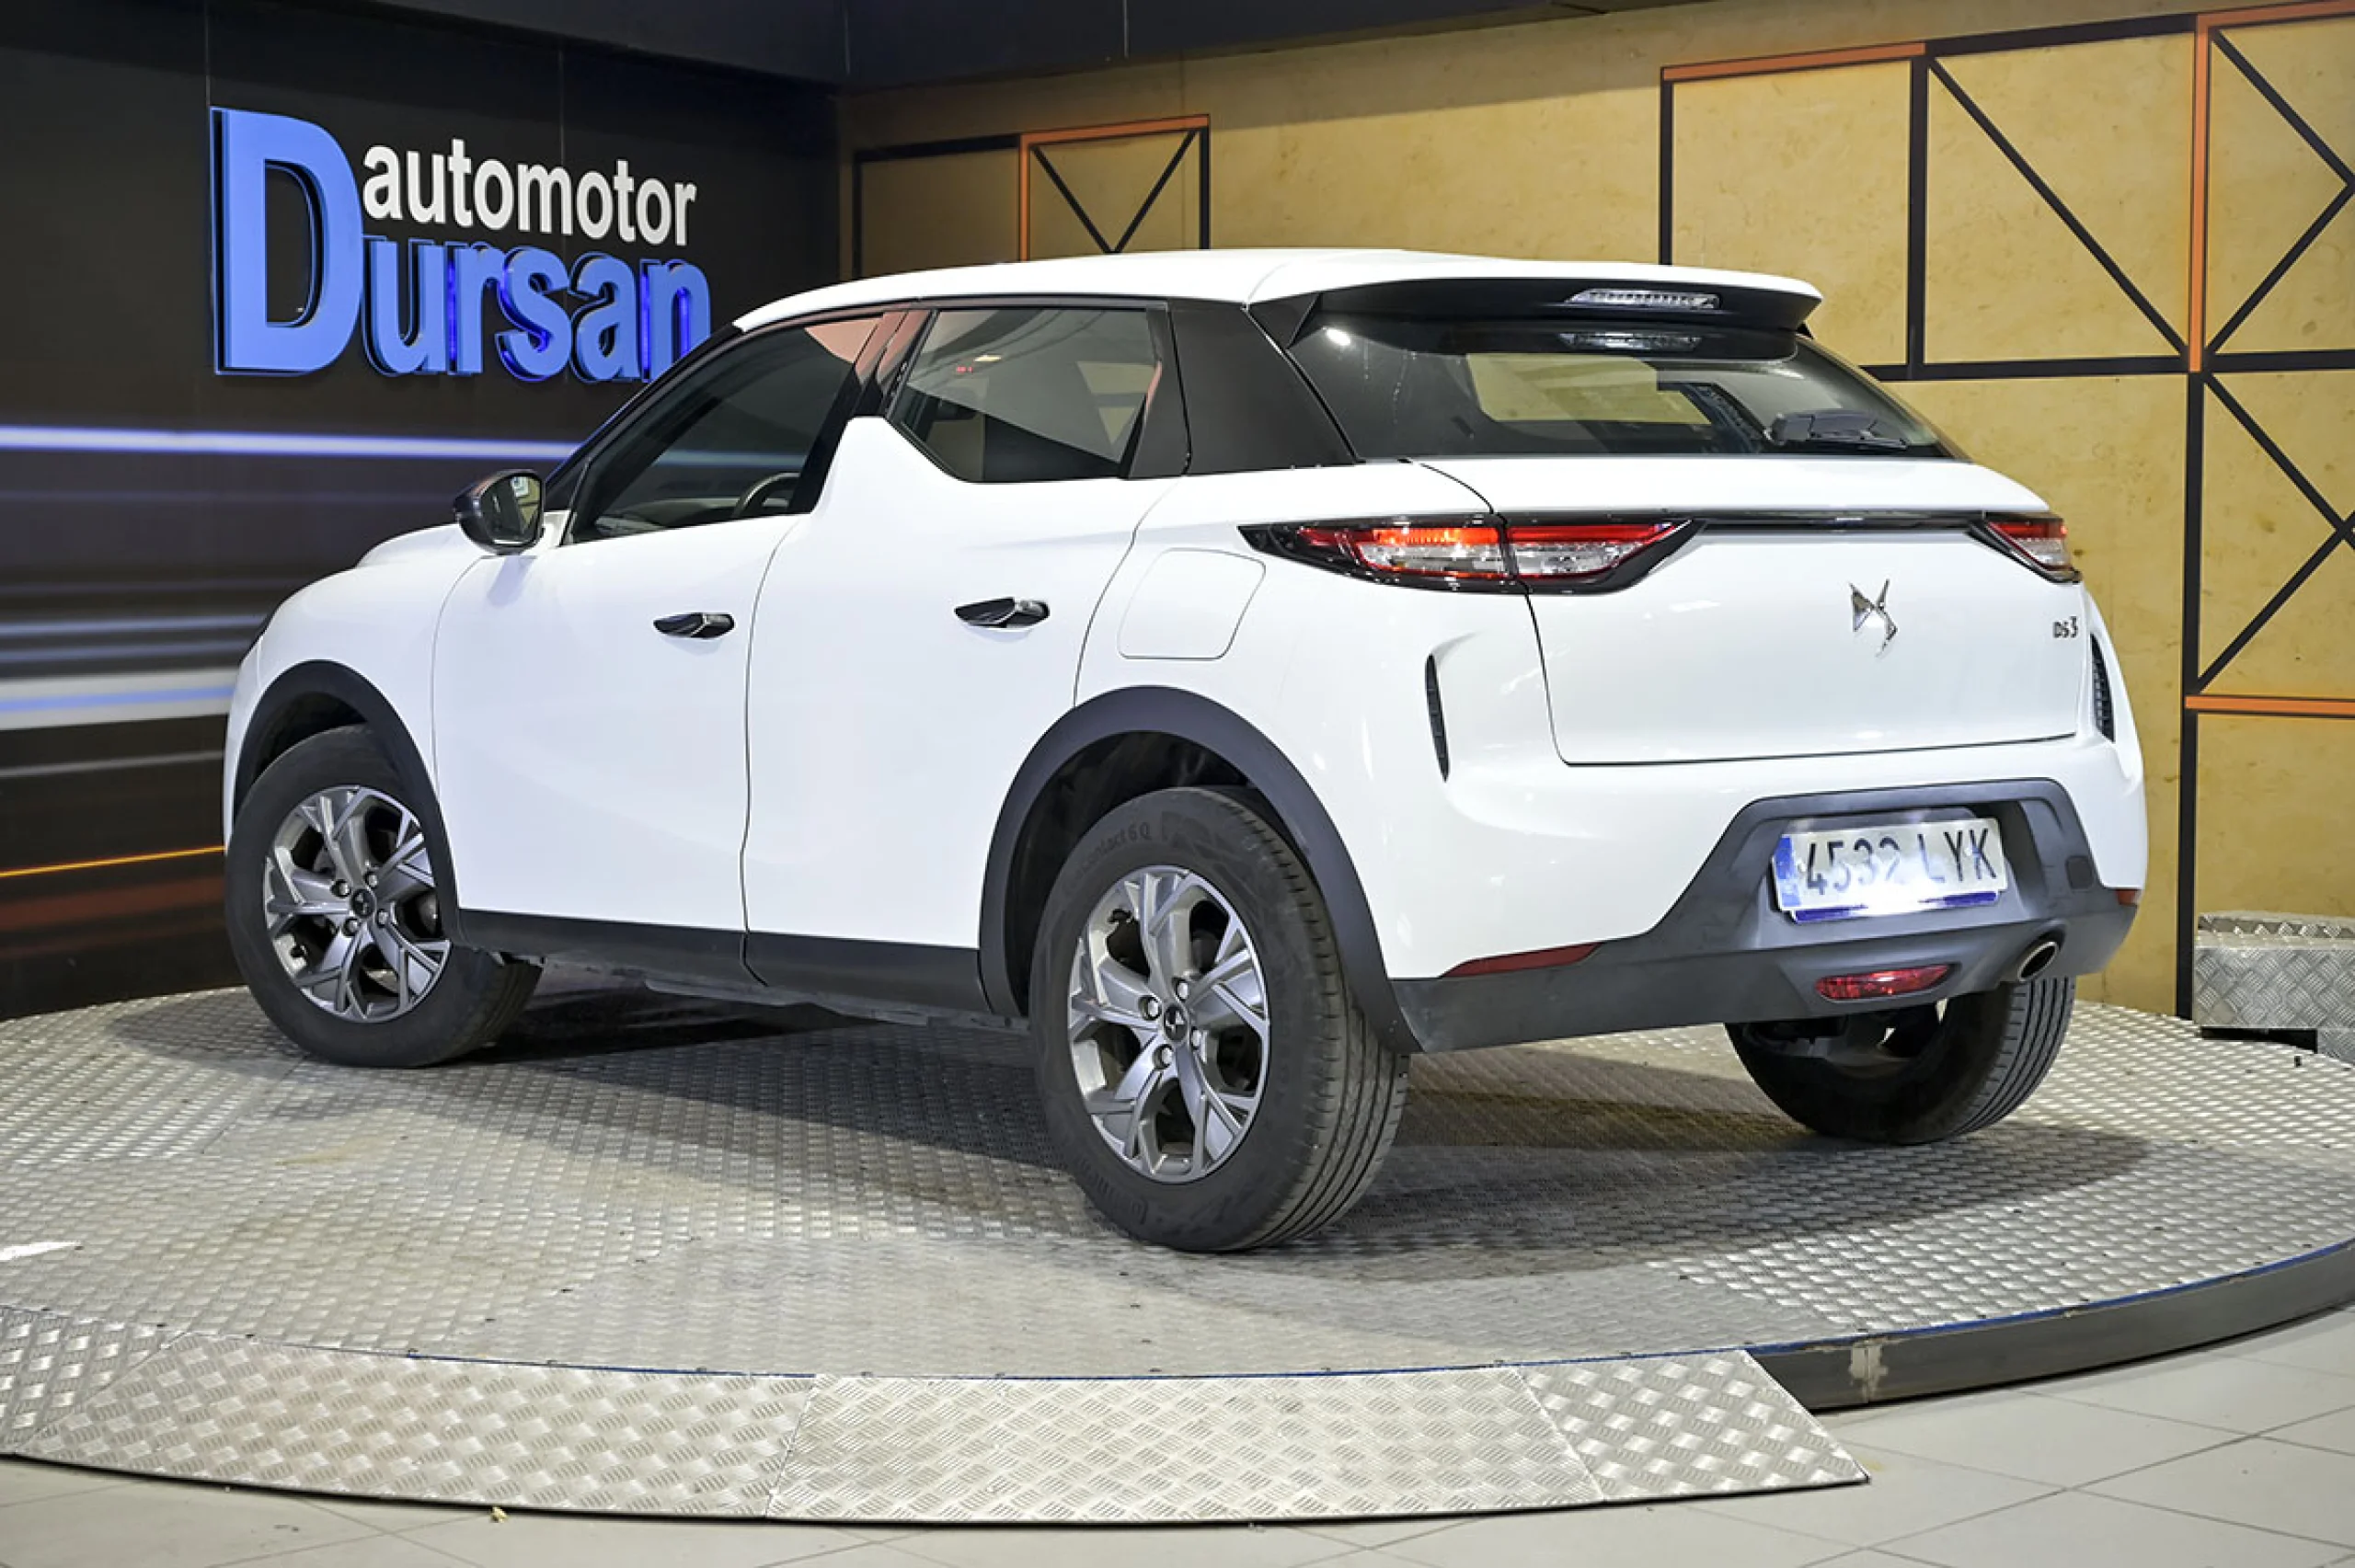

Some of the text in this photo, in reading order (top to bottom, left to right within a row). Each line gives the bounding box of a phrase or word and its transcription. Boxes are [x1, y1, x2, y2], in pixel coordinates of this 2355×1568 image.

[210, 105, 711, 383] Dursan
[364, 139, 697, 246] automotor
[1917, 829, 1997, 883] LYK
